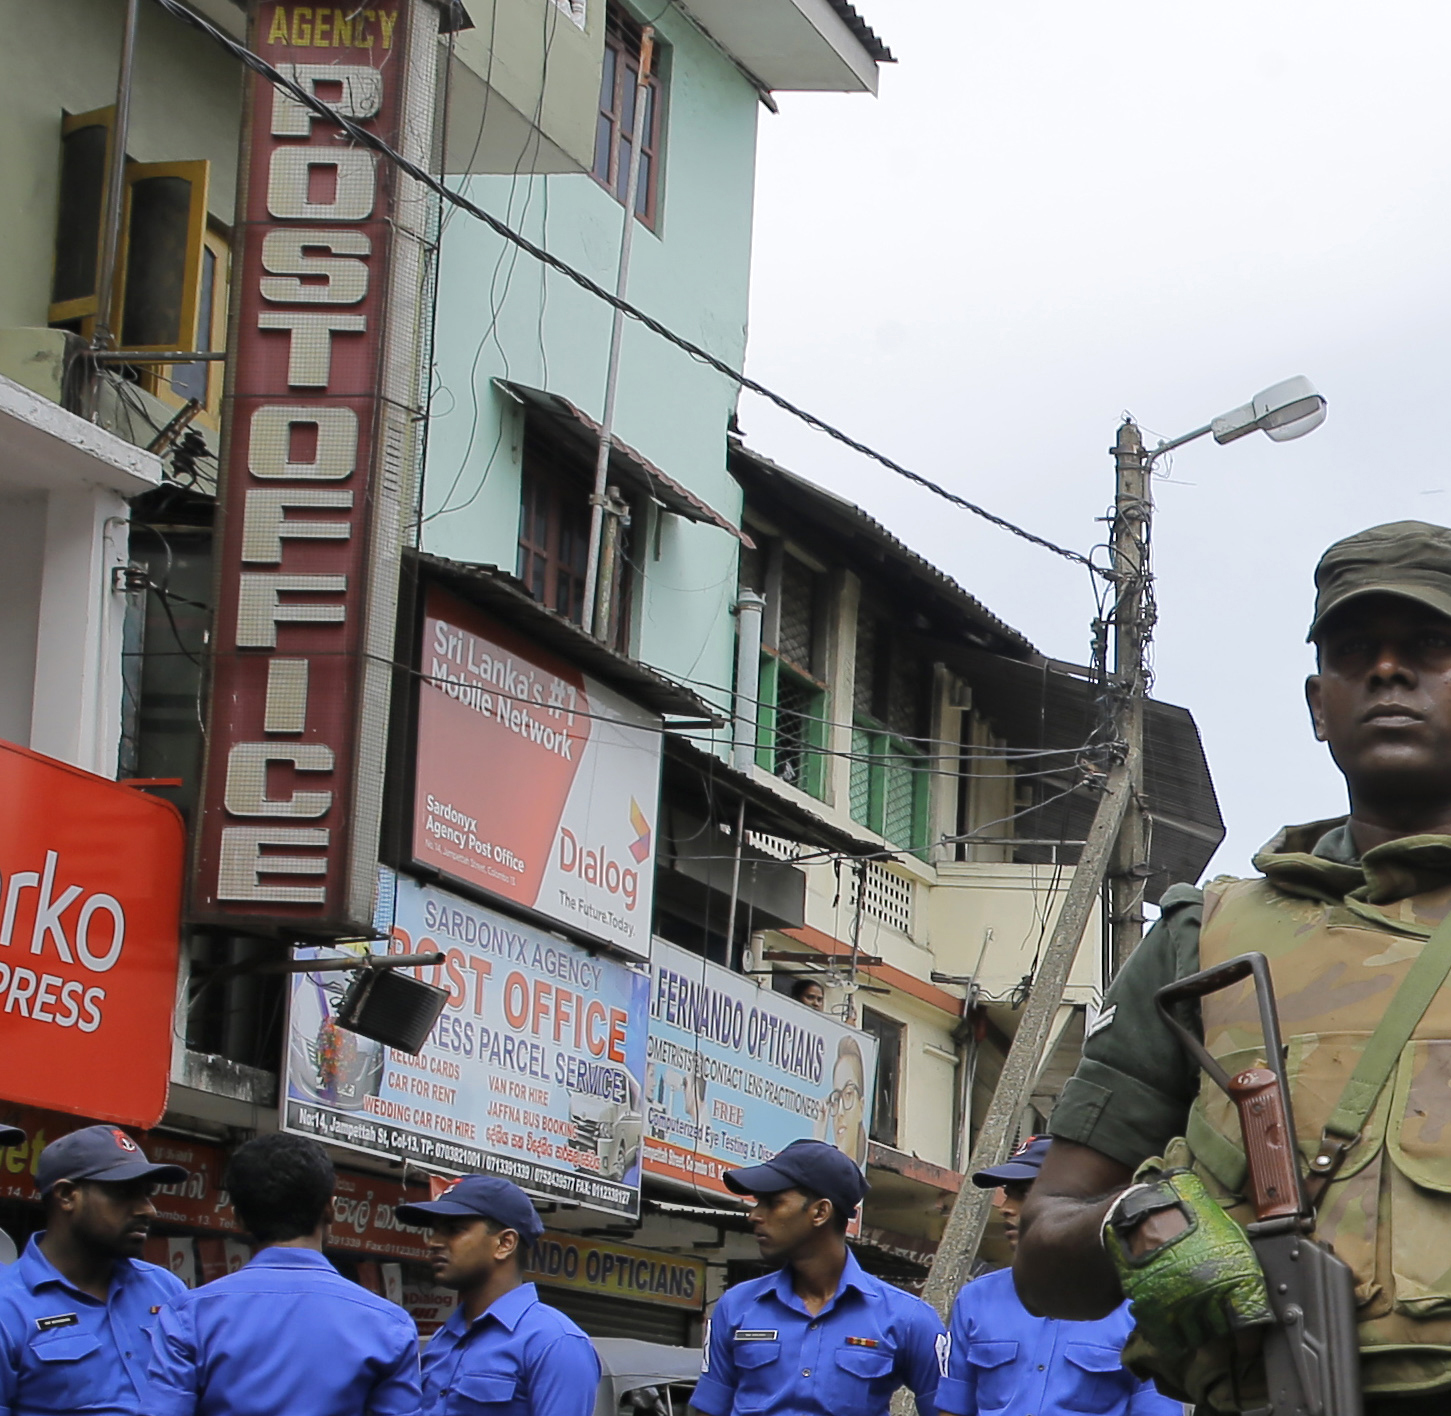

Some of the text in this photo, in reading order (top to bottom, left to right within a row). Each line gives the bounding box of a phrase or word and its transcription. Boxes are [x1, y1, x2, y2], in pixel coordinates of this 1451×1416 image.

[267, 6, 398, 49] AGENCY
[257, 63, 384, 387] POST
[217, 403, 359, 903] OFFICE
[434, 620, 463, 664] Sri
[548, 678, 577, 727] #1
[431, 657, 572, 761] Mobile Network
[426, 795, 477, 832] Sardonyx
[425, 815, 525, 873] Agency Post Office
[560, 826, 638, 911] Dialog
[0, 849, 125, 973] rko
[559, 890, 576, 910] The
[424, 900, 602, 993] SARDONYX AGENCY
[390, 926, 628, 1063] POST OFFICE
[390, 1049, 460, 1080] RELOAD CARDS
[479, 1027, 550, 1080] PARCEL
[555, 1052, 626, 1103] SERVICE
[748, 1006, 825, 1086] OPTICIANS
[388, 1072, 456, 1105] CAR FOR RENT
[489, 1075, 549, 1106] VAN FOR HIRE
[704, 1055, 743, 1092] CONTACT
[744, 1074, 763, 1099] LENS
[765, 1081, 820, 1121] PRACTITIONERS
[713, 1100, 745, 1128] FREE
[363, 1095, 476, 1140] WEDDING CAR FOR HIRE
[487, 1101, 578, 1140] JAFFNA BUS BOOKING
[648, 1107, 703, 1143] Computerized
[705, 1125, 719, 1149] Eye
[721, 1131, 749, 1160] Testing
[750, 1141, 756, 1159] &
[586, 1249, 696, 1299] OPTICIANS
